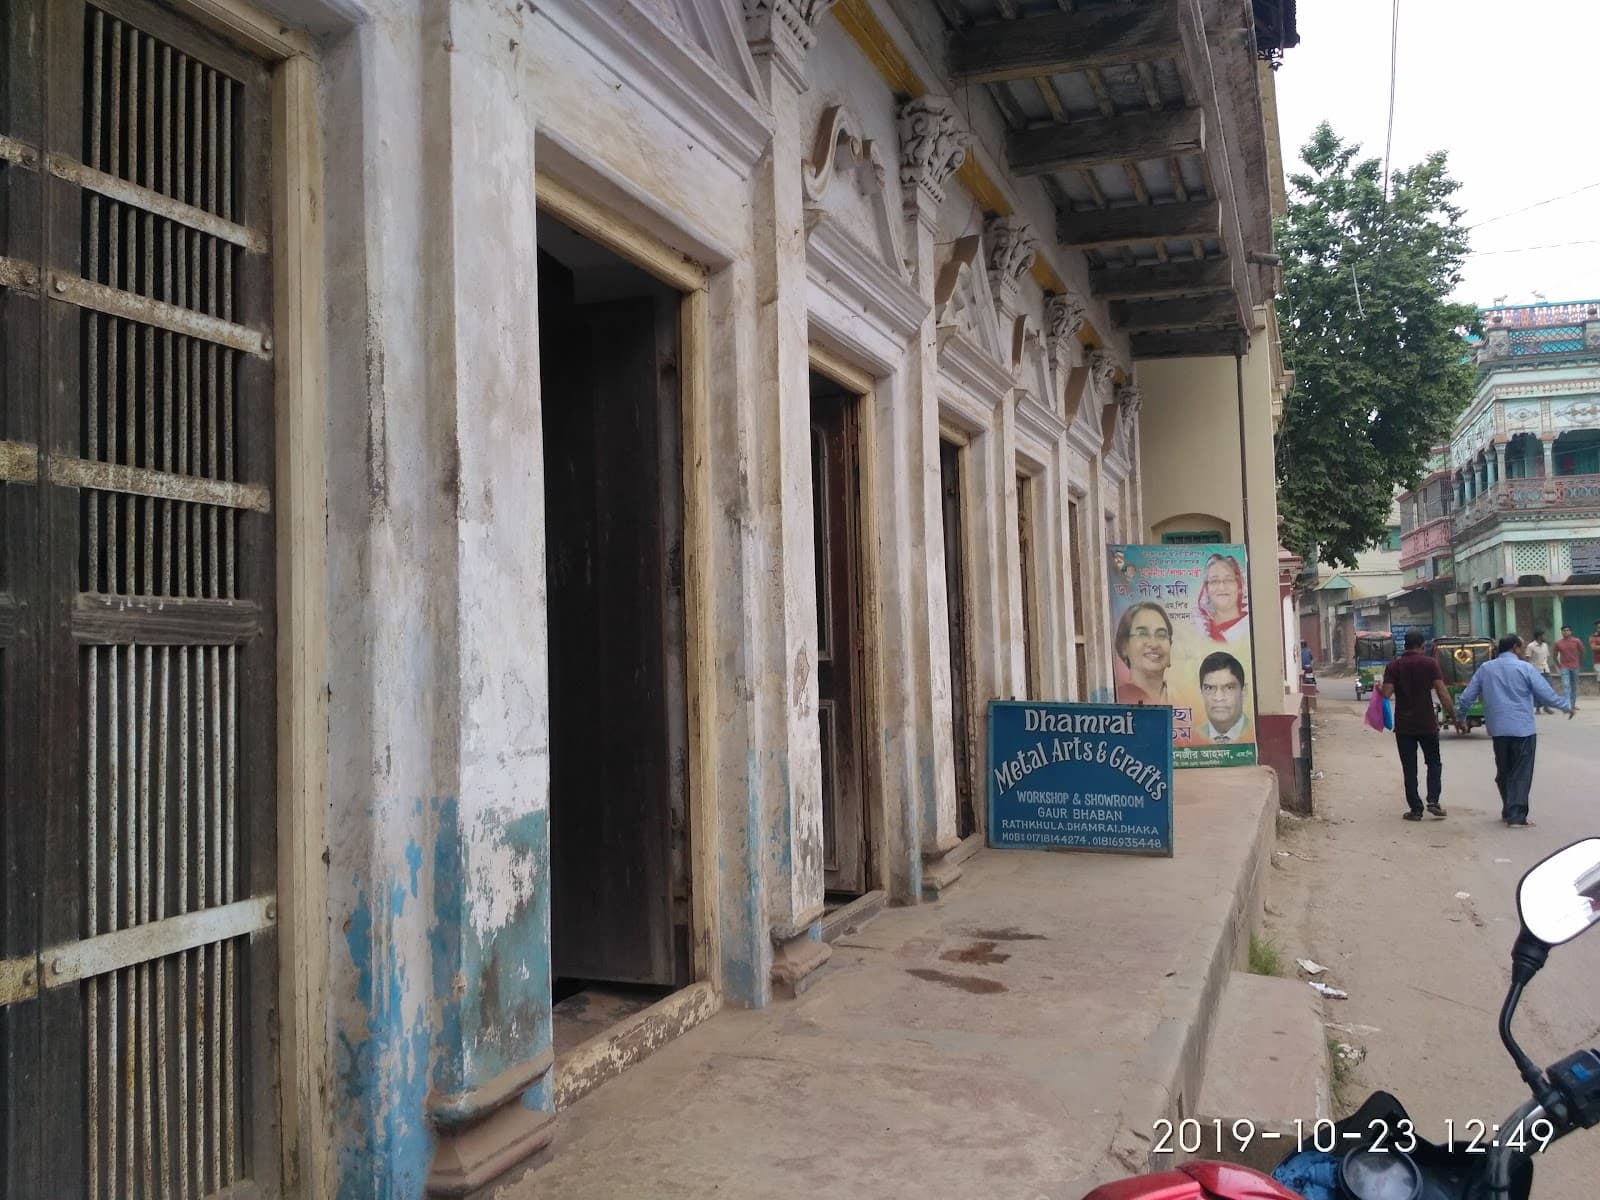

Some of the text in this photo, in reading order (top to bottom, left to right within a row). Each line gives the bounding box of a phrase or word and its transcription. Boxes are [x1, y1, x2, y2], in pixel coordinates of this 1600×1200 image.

[1138, 580, 1161, 598] দীপু
[1165, 580, 1188, 597] মনি
[1025, 709, 1135, 735] Dhamrai
[994, 737, 1167, 800] Metal Arts & Crafts
[1016, 790, 1145, 809] WORKSHOP & SHOWROOM
[1037, 806, 1122, 821] GAUR BHABAN
